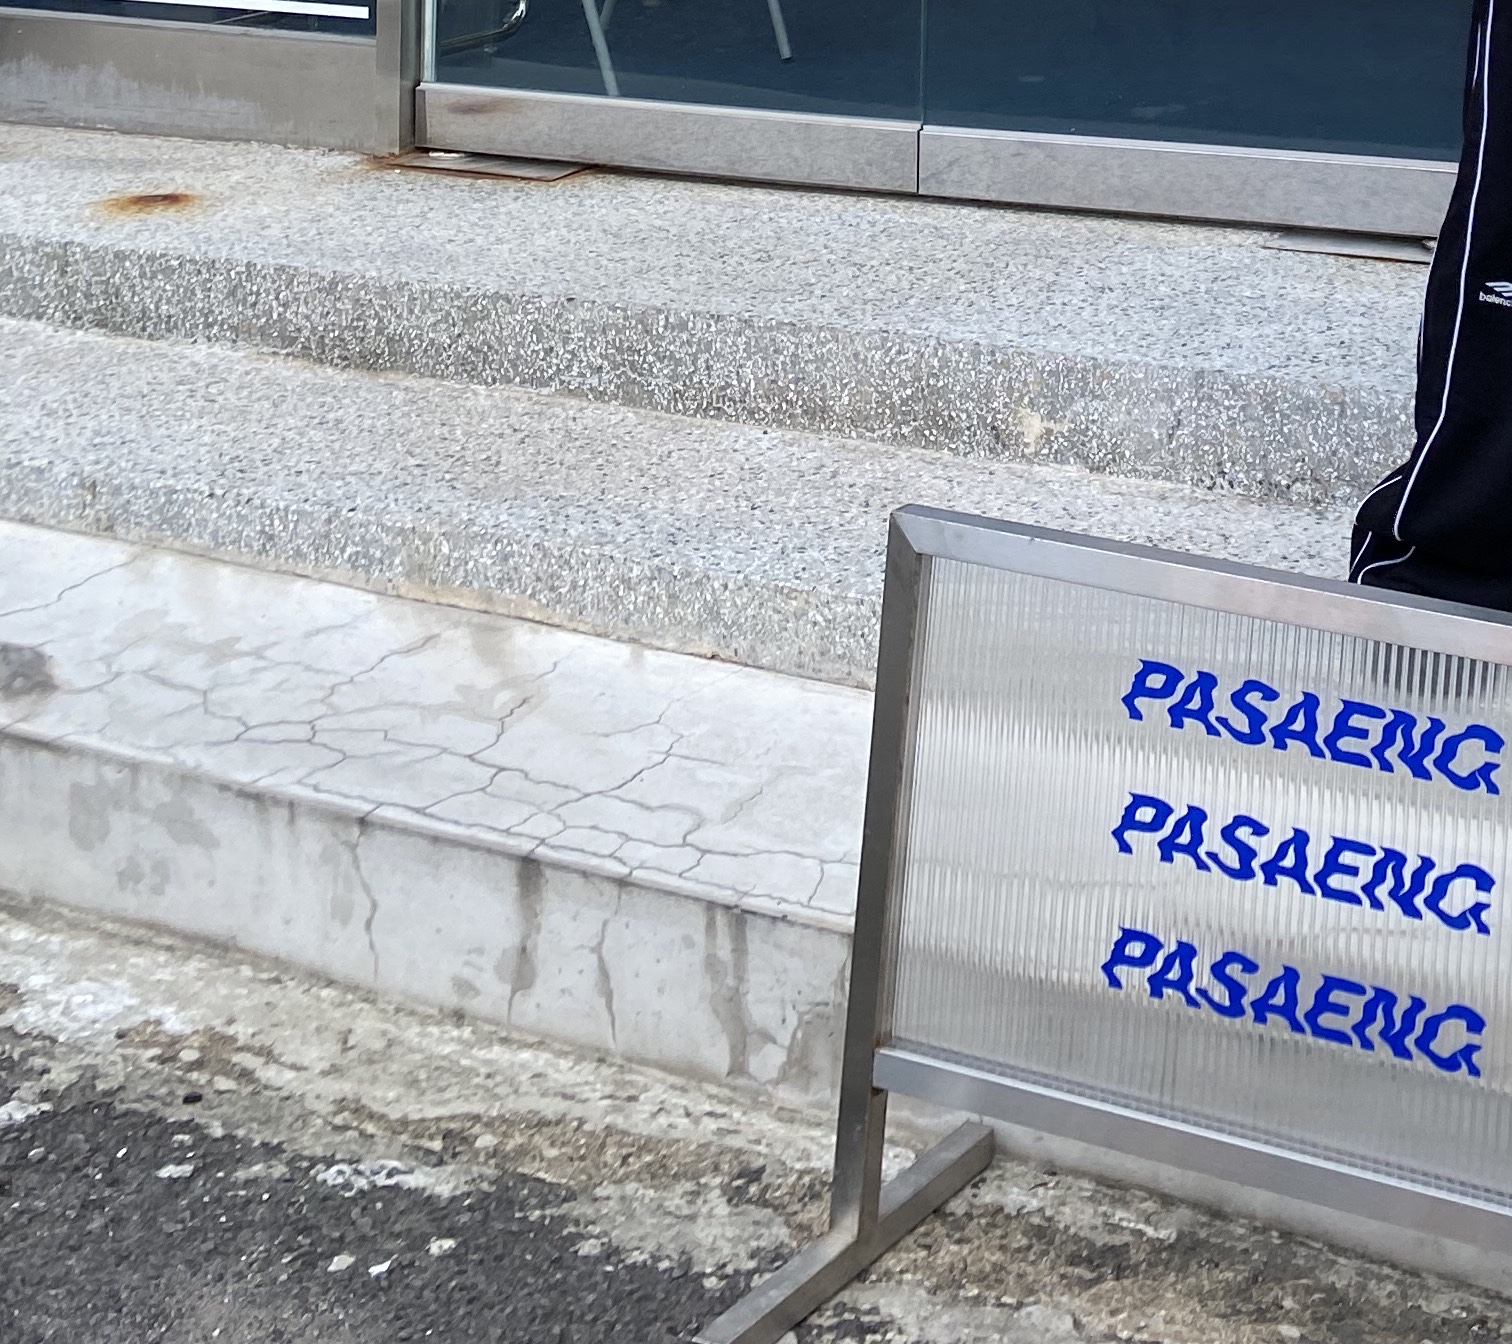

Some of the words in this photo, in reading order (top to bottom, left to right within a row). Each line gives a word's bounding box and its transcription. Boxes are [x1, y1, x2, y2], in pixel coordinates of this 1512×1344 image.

[1120, 658, 1506, 795] PASAENG
[1110, 791, 1496, 936] PASAENG
[1101, 927, 1488, 1077] PASAENG
